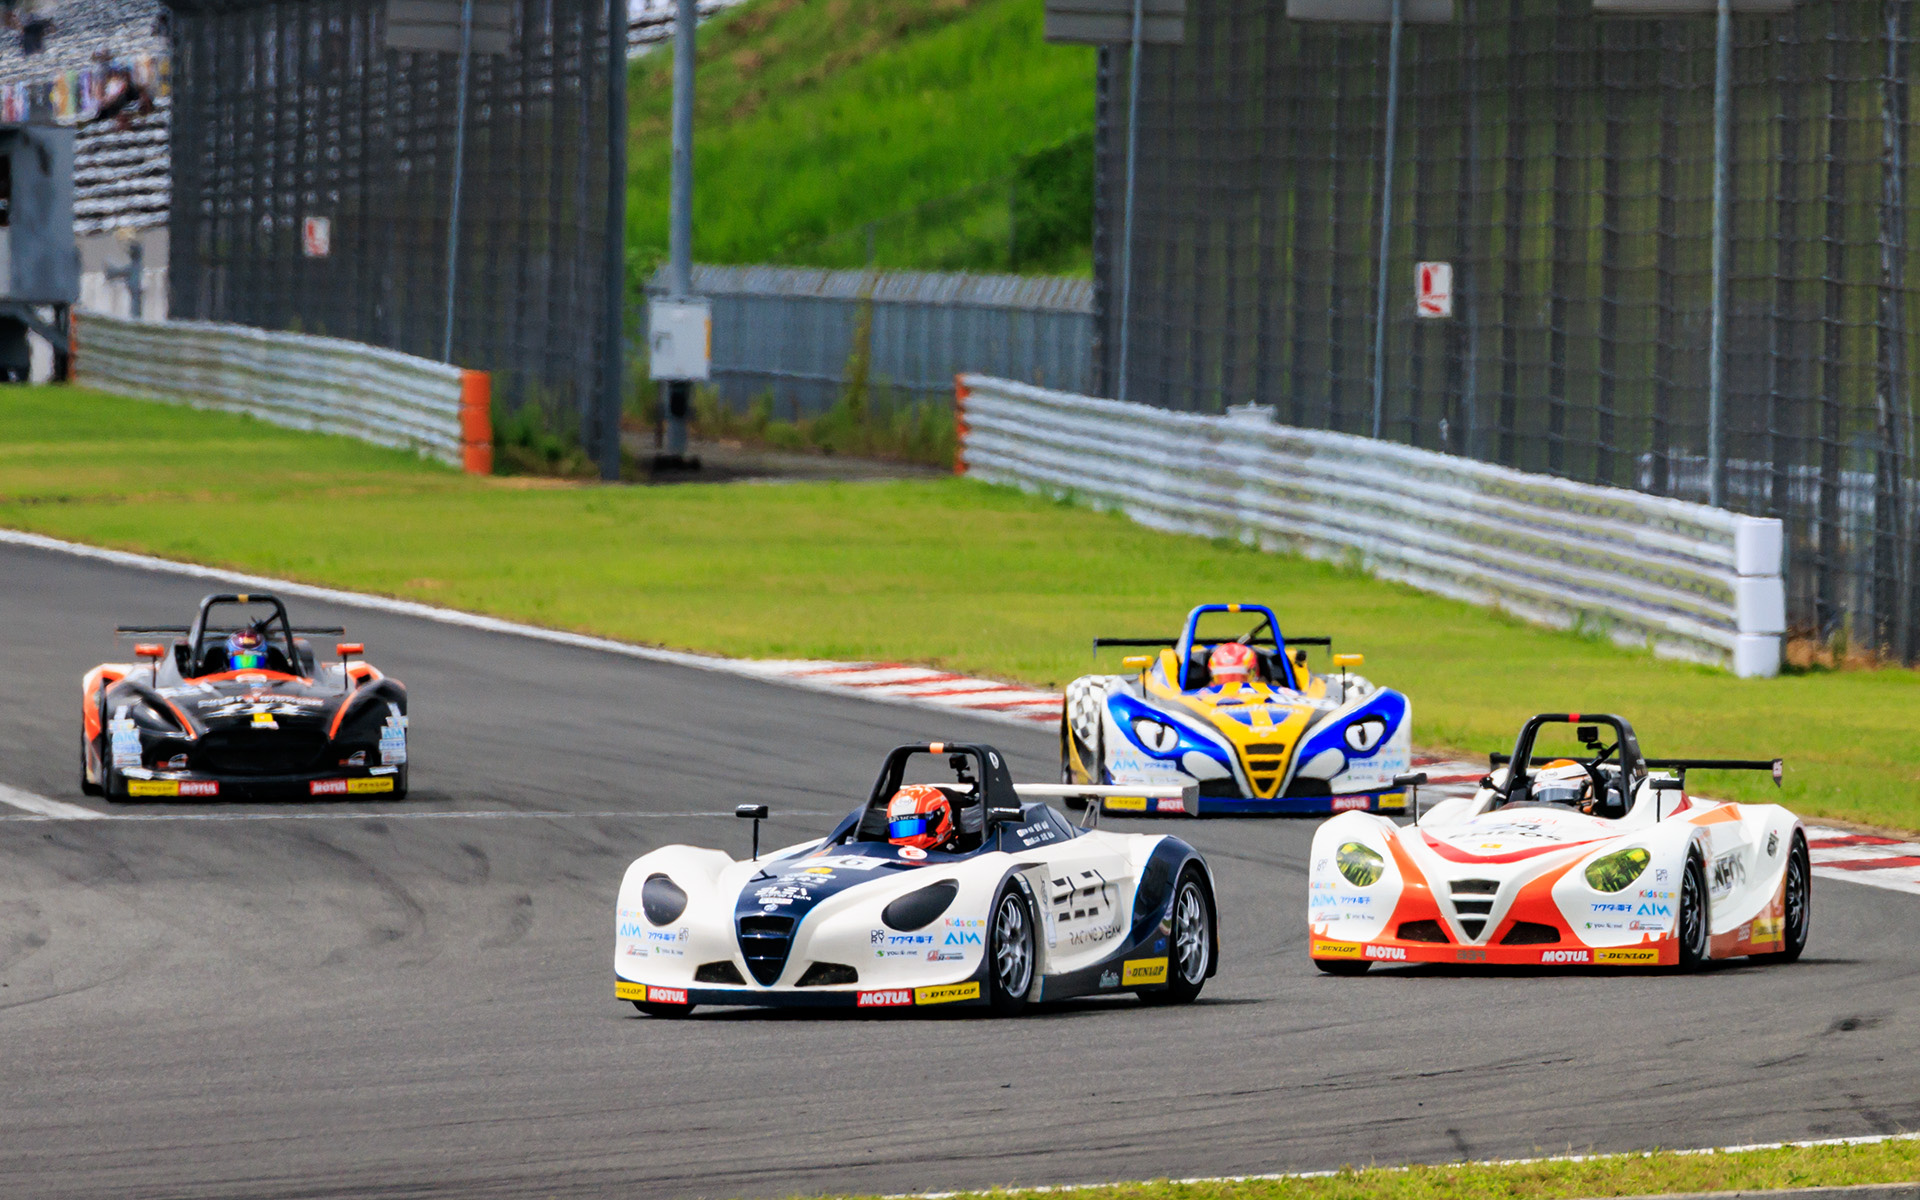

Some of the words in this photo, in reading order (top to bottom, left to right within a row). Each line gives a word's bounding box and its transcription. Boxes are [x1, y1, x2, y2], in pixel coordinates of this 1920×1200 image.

[180, 783, 217, 794] MOTUL
[312, 781, 346, 793] MOTUL
[1365, 945, 1407, 960] MOTUL
[1541, 950, 1589, 962] MOTUL
[1608, 952, 1654, 960] DUNLOP
[1132, 965, 1164, 977] DUNLOP
[649, 988, 686, 1003] MOTUL
[860, 991, 910, 1005] MOTUL
[930, 988, 977, 998] DUNLOP
